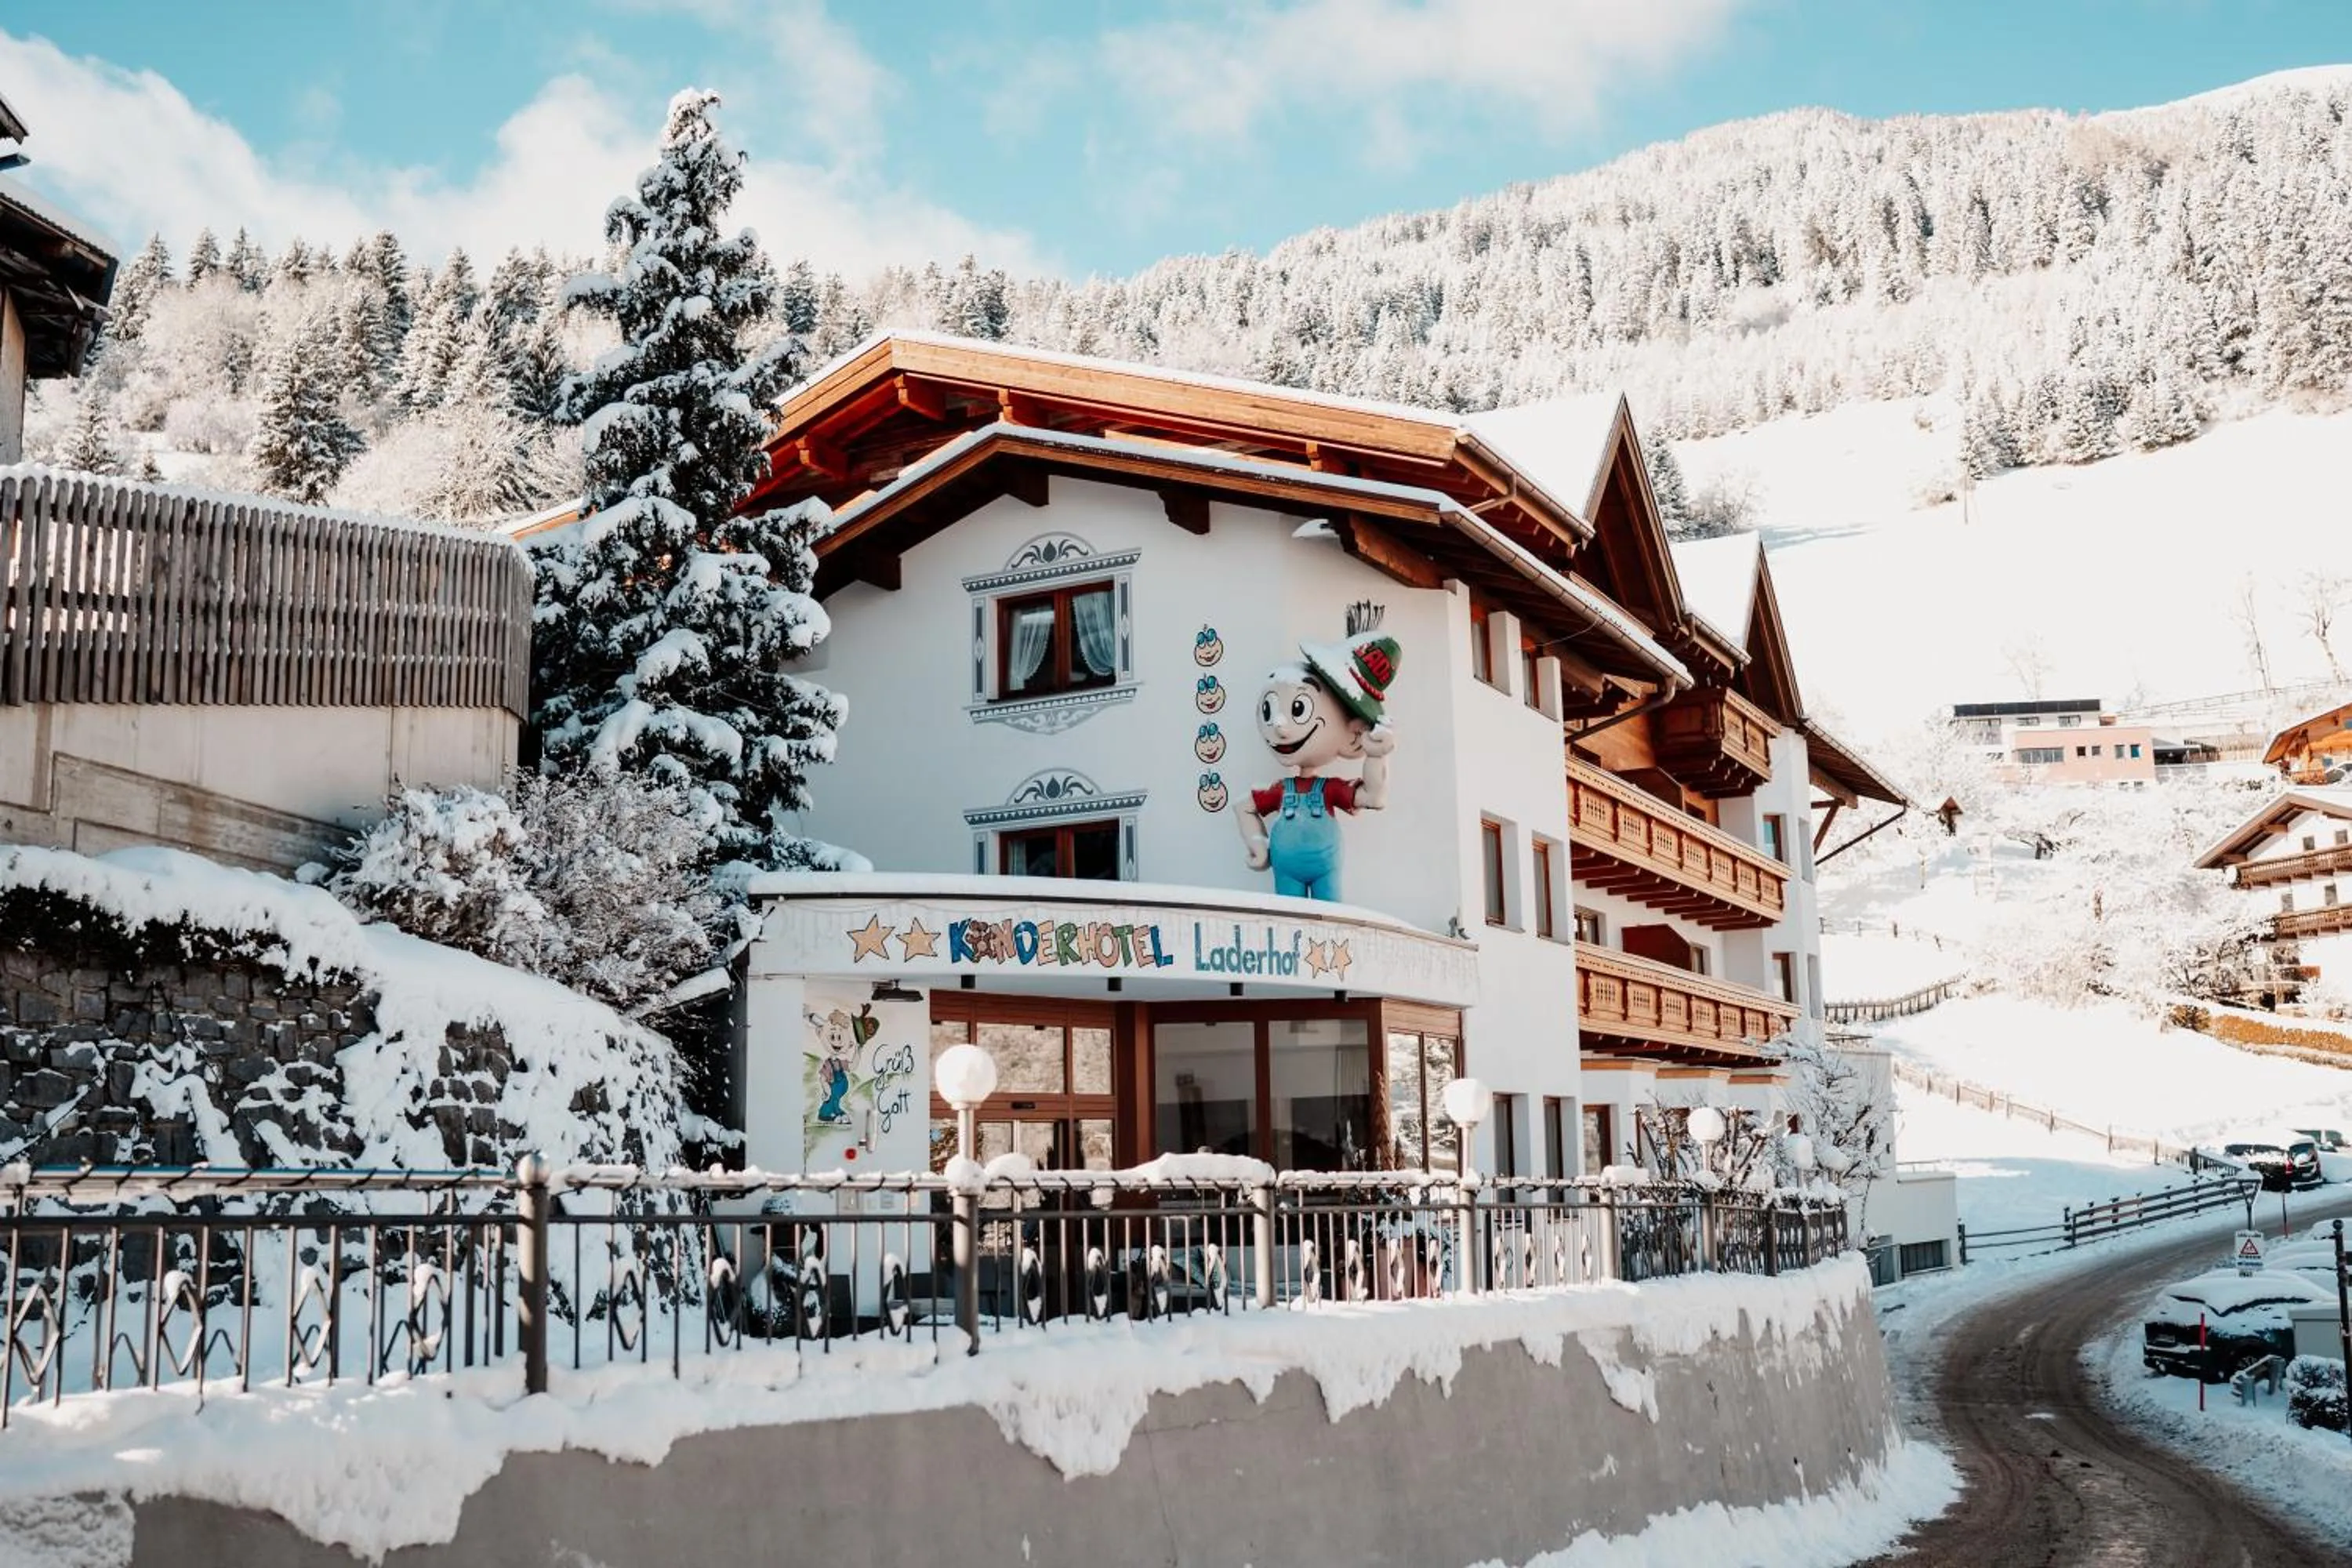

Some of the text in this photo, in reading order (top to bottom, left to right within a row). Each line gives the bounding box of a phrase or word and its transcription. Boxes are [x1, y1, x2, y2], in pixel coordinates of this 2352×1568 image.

[1194, 922, 1301, 976] Laderhof
[872, 1043, 915, 1091] Grüß
[877, 1088, 911, 1134] Gott
